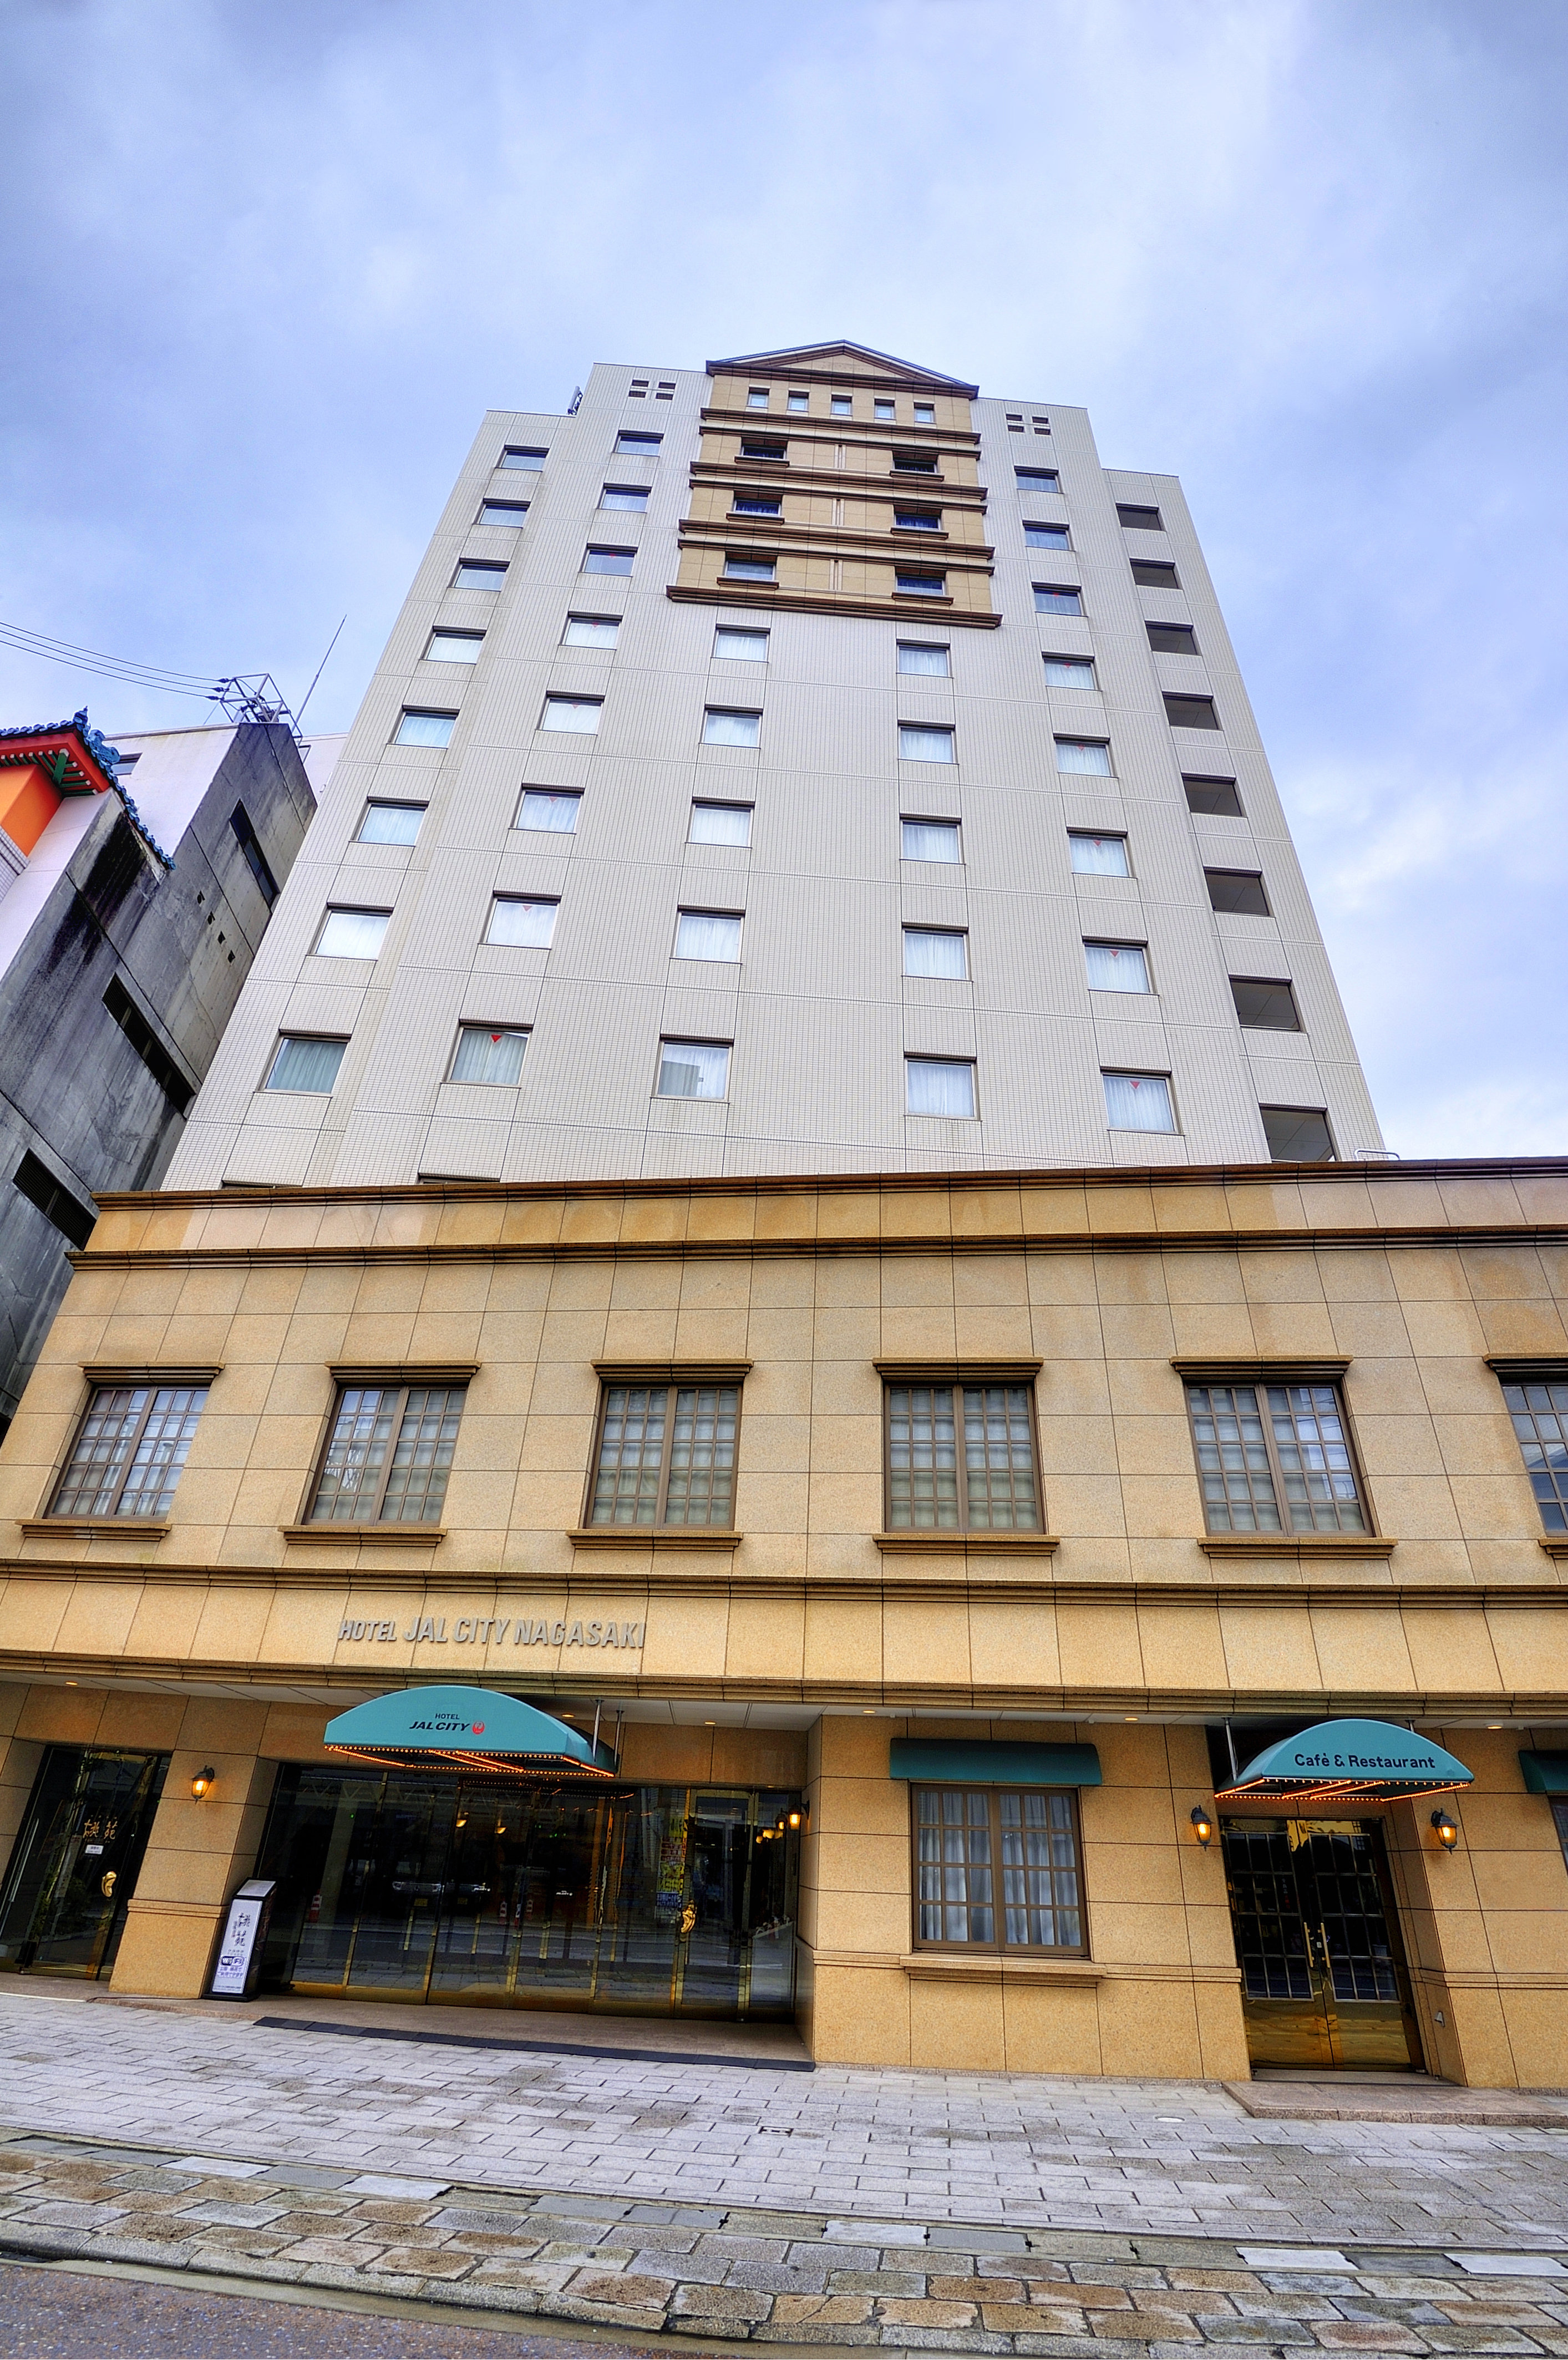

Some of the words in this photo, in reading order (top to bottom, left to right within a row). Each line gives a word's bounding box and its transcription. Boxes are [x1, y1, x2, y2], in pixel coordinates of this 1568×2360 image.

[338, 1620, 397, 1641] HOTEL
[404, 1617, 448, 1642] JAL
[454, 1617, 510, 1644] CITY
[514, 1619, 646, 1648] NAGASAKI
[1334, 1754, 1345, 1767] &
[1348, 1754, 1435, 1768] Restaurant
